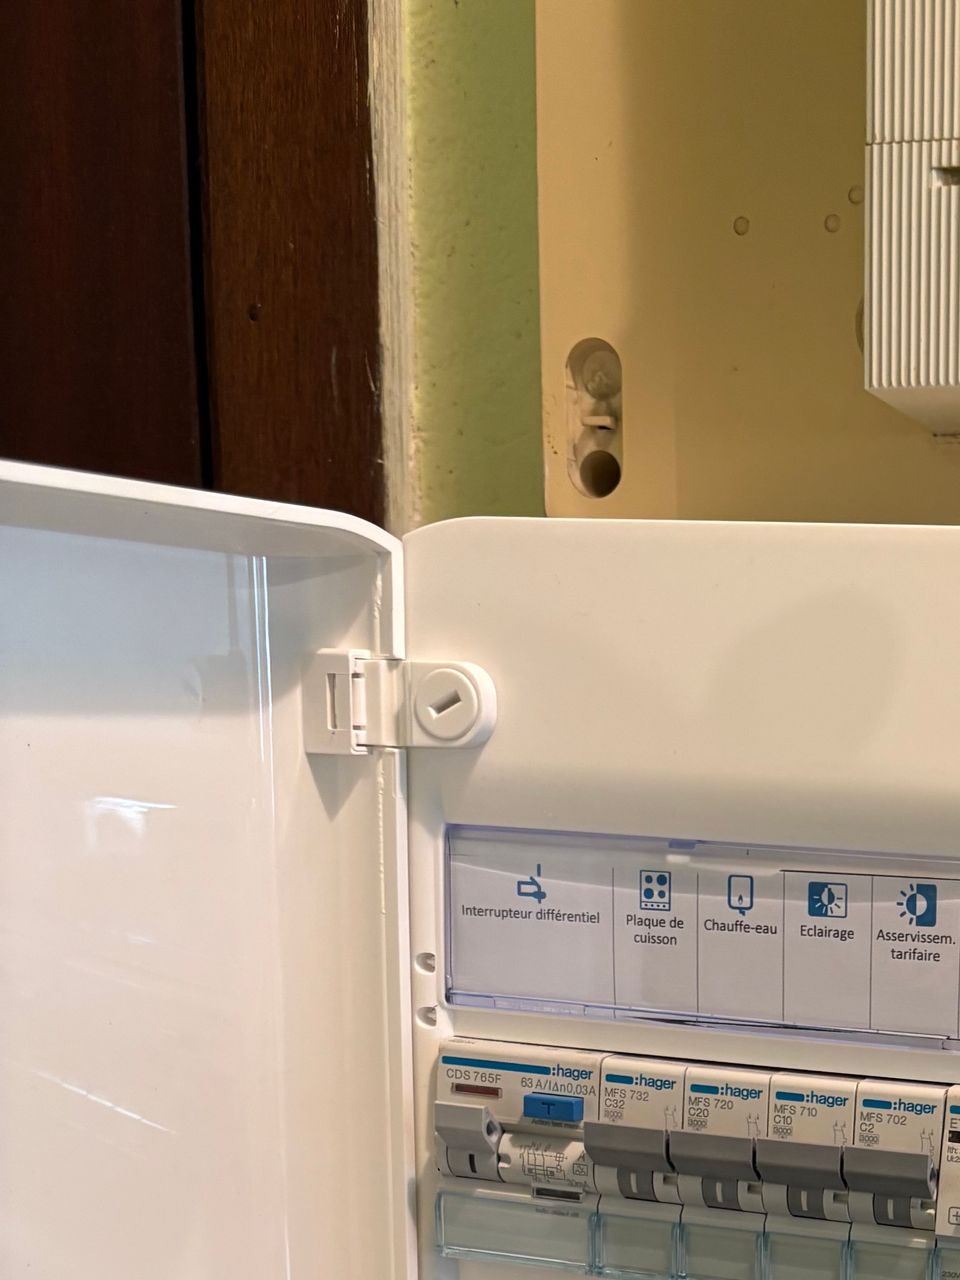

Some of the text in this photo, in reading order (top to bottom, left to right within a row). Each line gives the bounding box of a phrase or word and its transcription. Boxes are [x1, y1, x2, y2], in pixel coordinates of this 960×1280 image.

[461, 904, 600, 924] Interrupteur différentiel
[626, 914, 684, 932] Plaque de
[704, 919, 777, 935] Chauffe-eau
[634, 932, 677, 946] cuisson
[800, 925, 855, 941] Eclairage
[876, 929, 956, 945] Asservissem.
[891, 947, 940, 962] tarifaire
[446, 1068, 471, 1080] CDS
[605, 1088, 649, 1101] MFS 732
[605, 1098, 625, 1109] C32
[688, 1096, 733, 1110] MFS 720
[688, 1107, 709, 1117] C20
[774, 1104, 817, 1117] MFS 710
[774, 1115, 792, 1125] C10
[860, 1112, 907, 1125] MFS 702
[860, 1123, 874, 1133] C2
